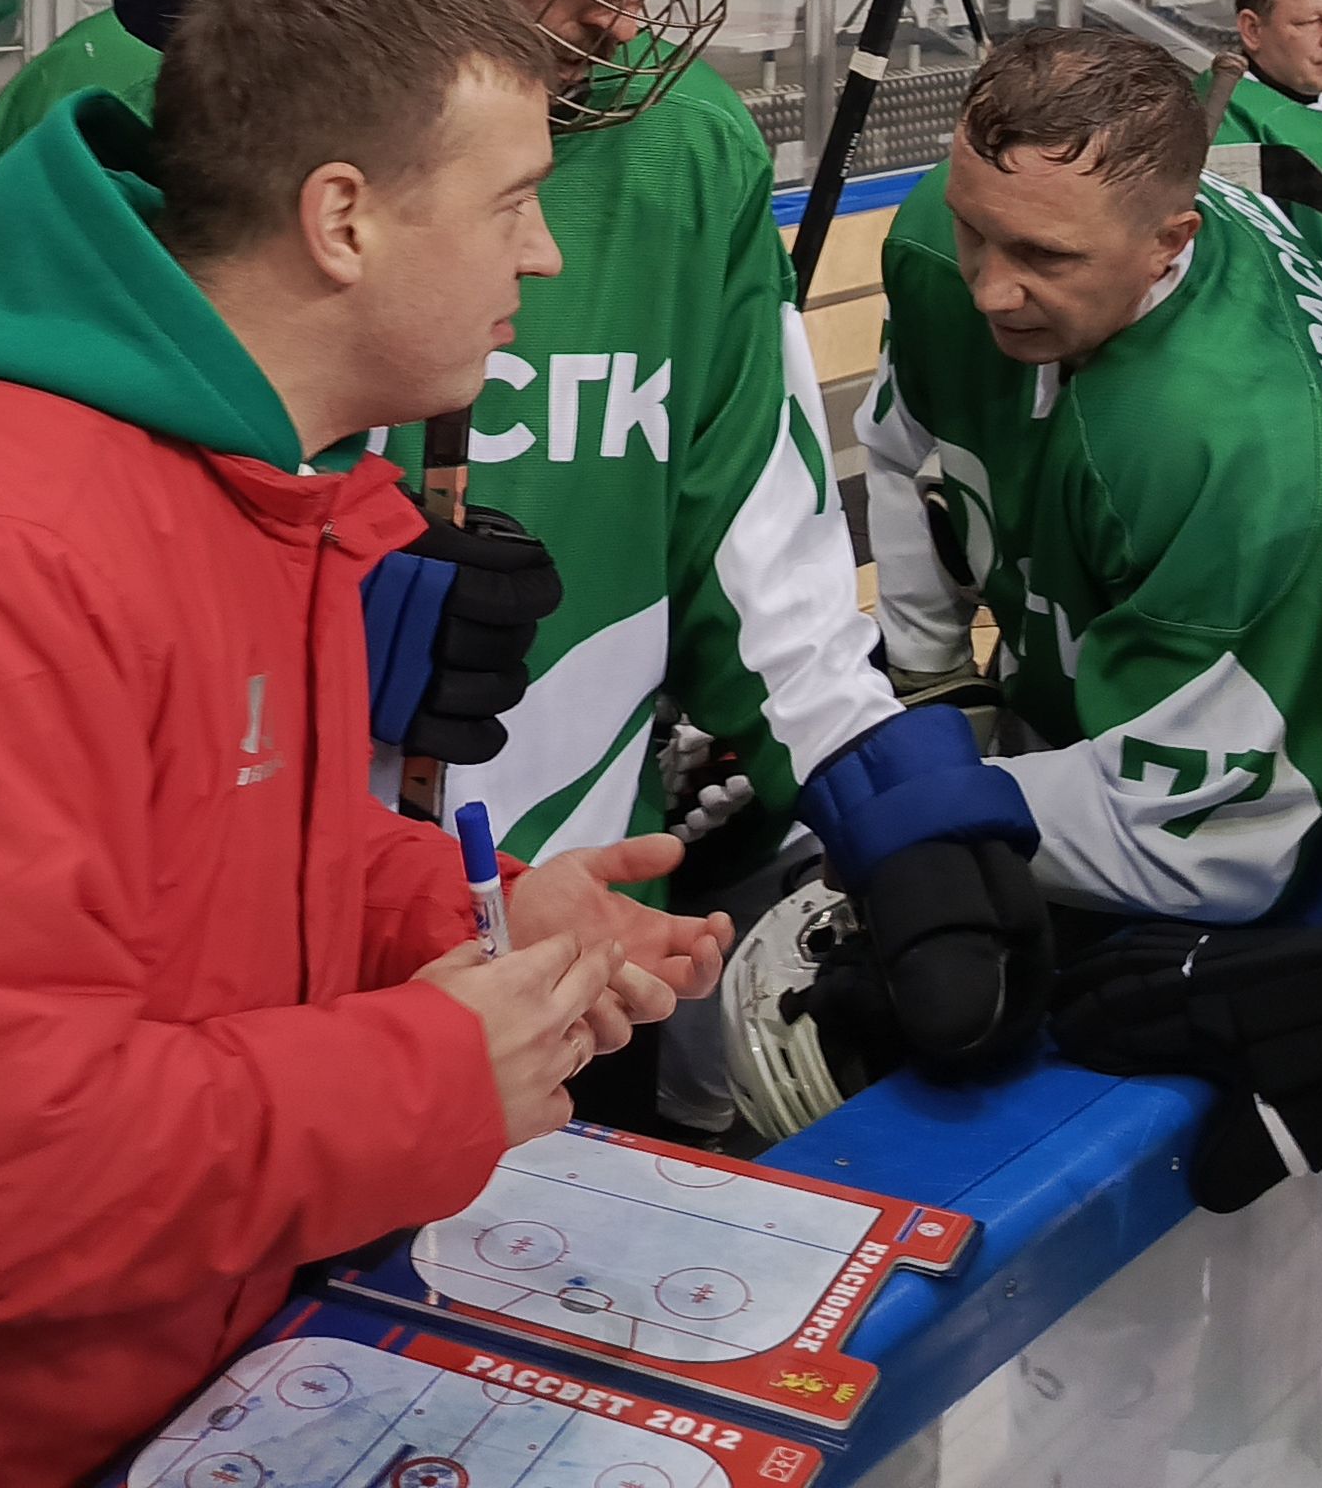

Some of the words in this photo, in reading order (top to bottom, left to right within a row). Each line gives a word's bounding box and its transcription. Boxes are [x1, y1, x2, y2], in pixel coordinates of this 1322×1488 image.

[792, 1240, 890, 1354] КРАСНОЯРСК
[464, 1355, 635, 1416] РАССВЕТ
[644, 1408, 743, 1451] 2012
